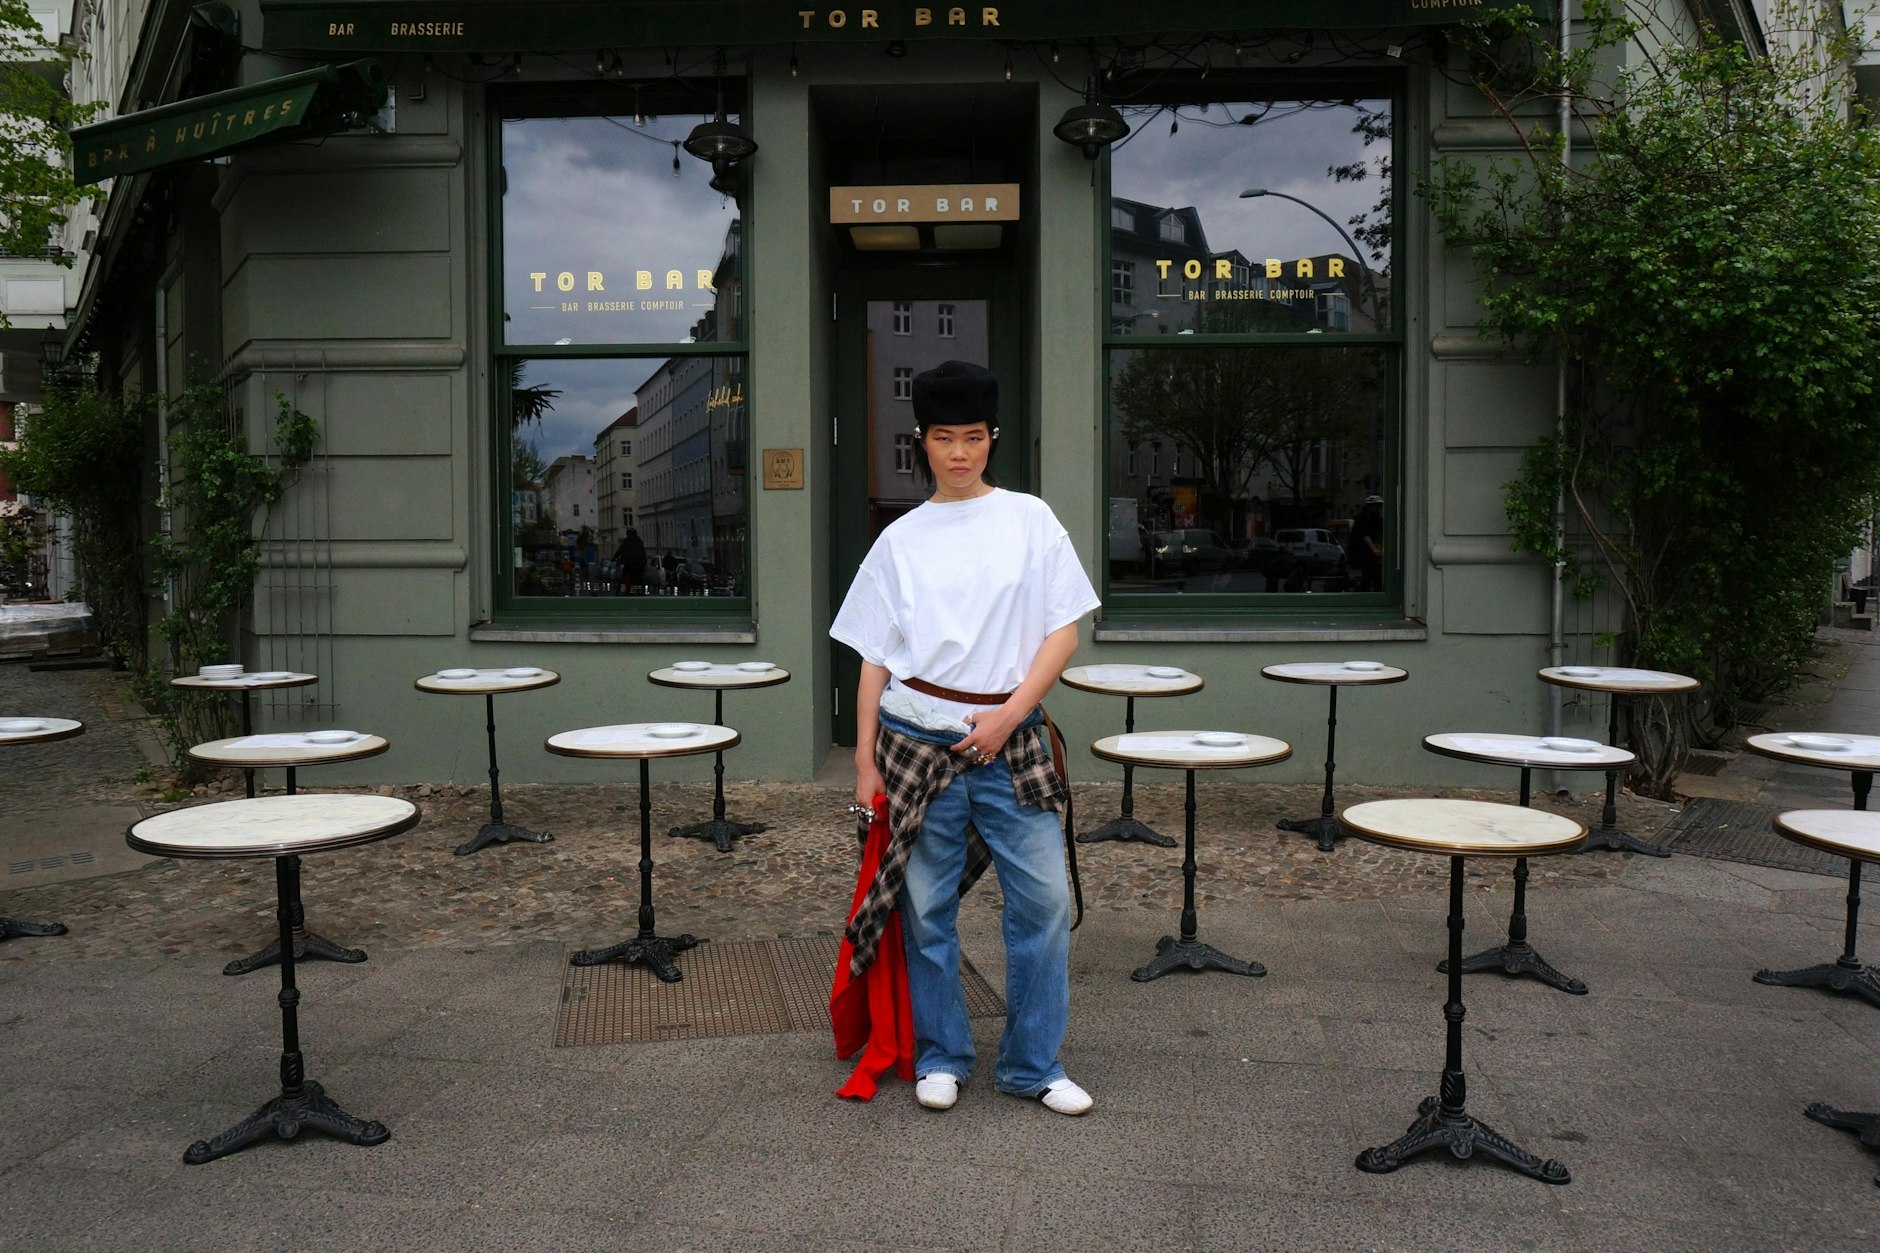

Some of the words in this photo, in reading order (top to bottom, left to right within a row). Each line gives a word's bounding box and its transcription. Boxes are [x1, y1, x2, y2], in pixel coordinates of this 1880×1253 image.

[799, 9, 879, 29] TOR
[915, 7, 1000, 26] BAR
[329, 23, 355, 36] BAR
[391, 22, 464, 36] BRASSERIE
[146, 128, 156, 152] À
[176, 99, 293, 144] HUÎTRES
[851, 199, 910, 214] TOR
[936, 197, 998, 212] BAR
[1156, 259, 1232, 279] TOR
[1265, 258, 1345, 279] BAR
[530, 271, 604, 292] TOR
[636, 269, 715, 290] BAR
[1189, 290, 1206, 300] BAR
[1215, 289, 1264, 300] BRASSERIE
[1270, 289, 1315, 300] COMPTOIR
[562, 302, 578, 312] BAR
[587, 301, 635, 311] BRASSERIE
[641, 300, 684, 311] COMPTOIR
